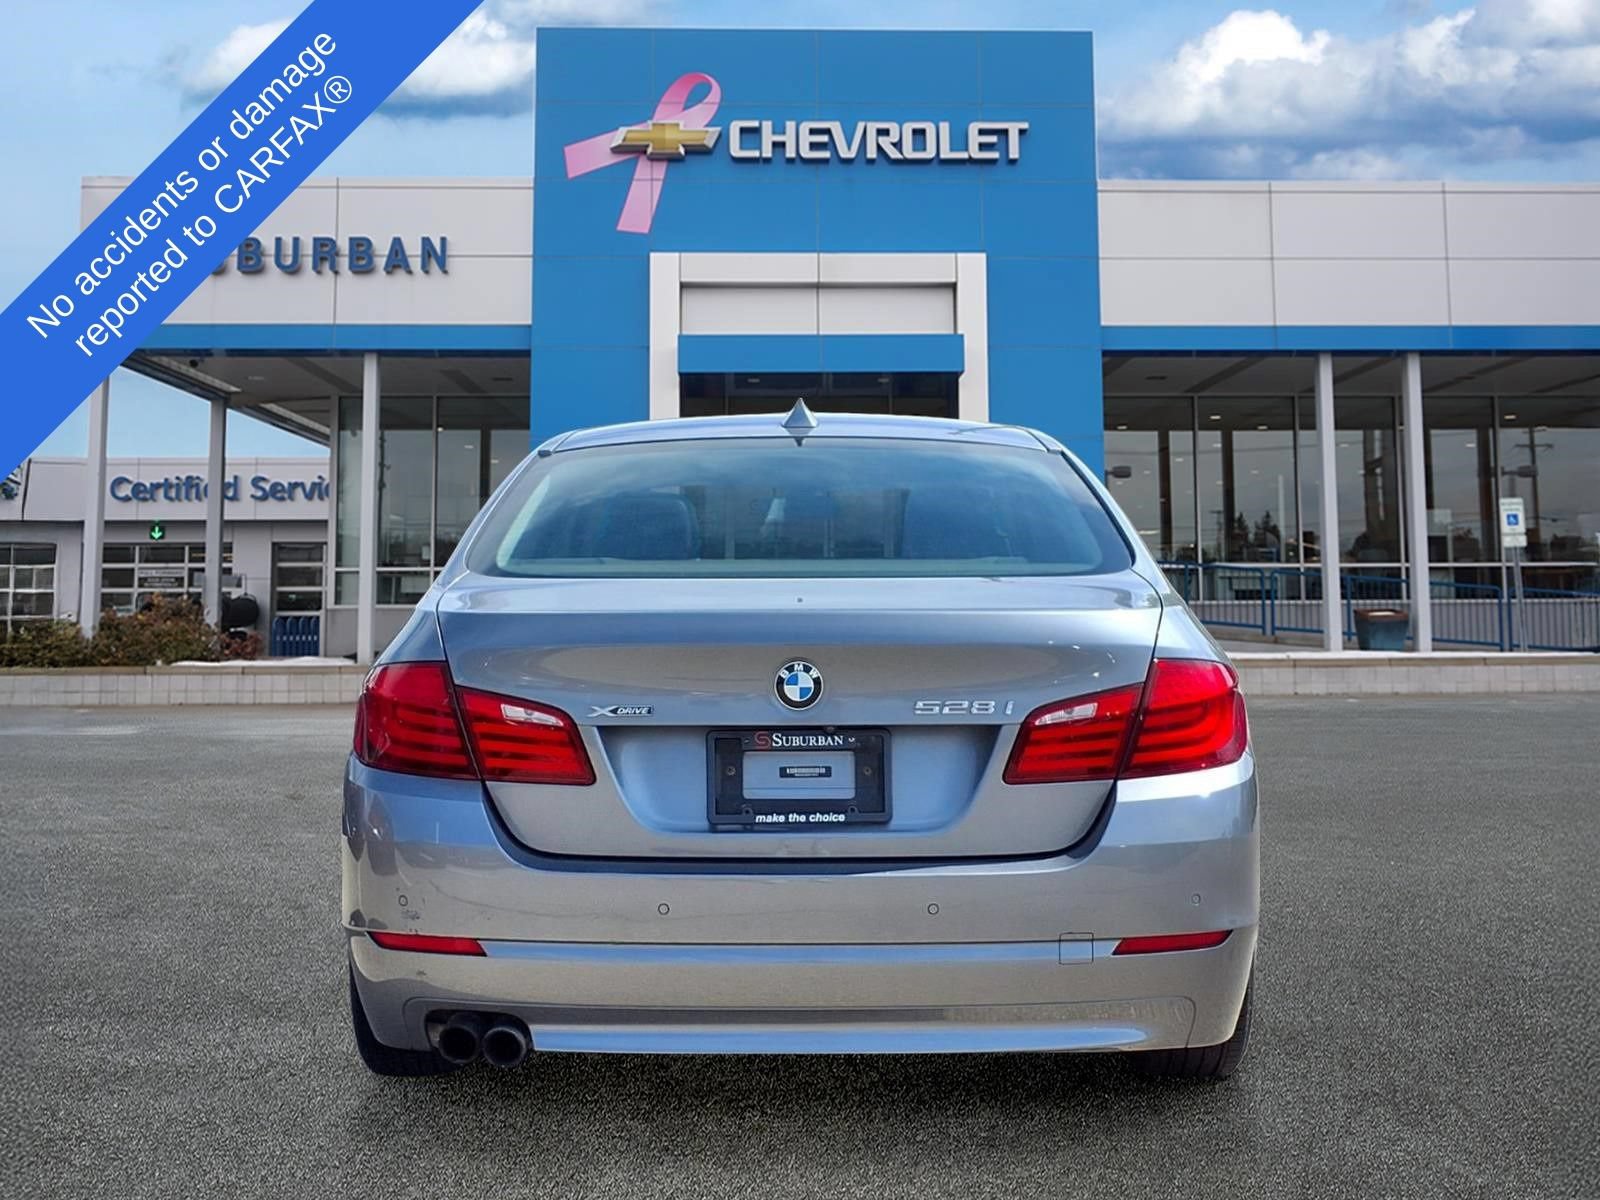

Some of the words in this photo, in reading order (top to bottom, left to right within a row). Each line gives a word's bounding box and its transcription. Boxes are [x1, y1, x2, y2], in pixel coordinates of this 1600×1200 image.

[729, 119, 1029, 162] CHEVROLET
[202, 236, 448, 274] BURBAN
[110, 476, 240, 502] Certifid
[755, 813, 785, 823] make
[788, 812, 806, 823] the
[809, 812, 846, 823] choice
